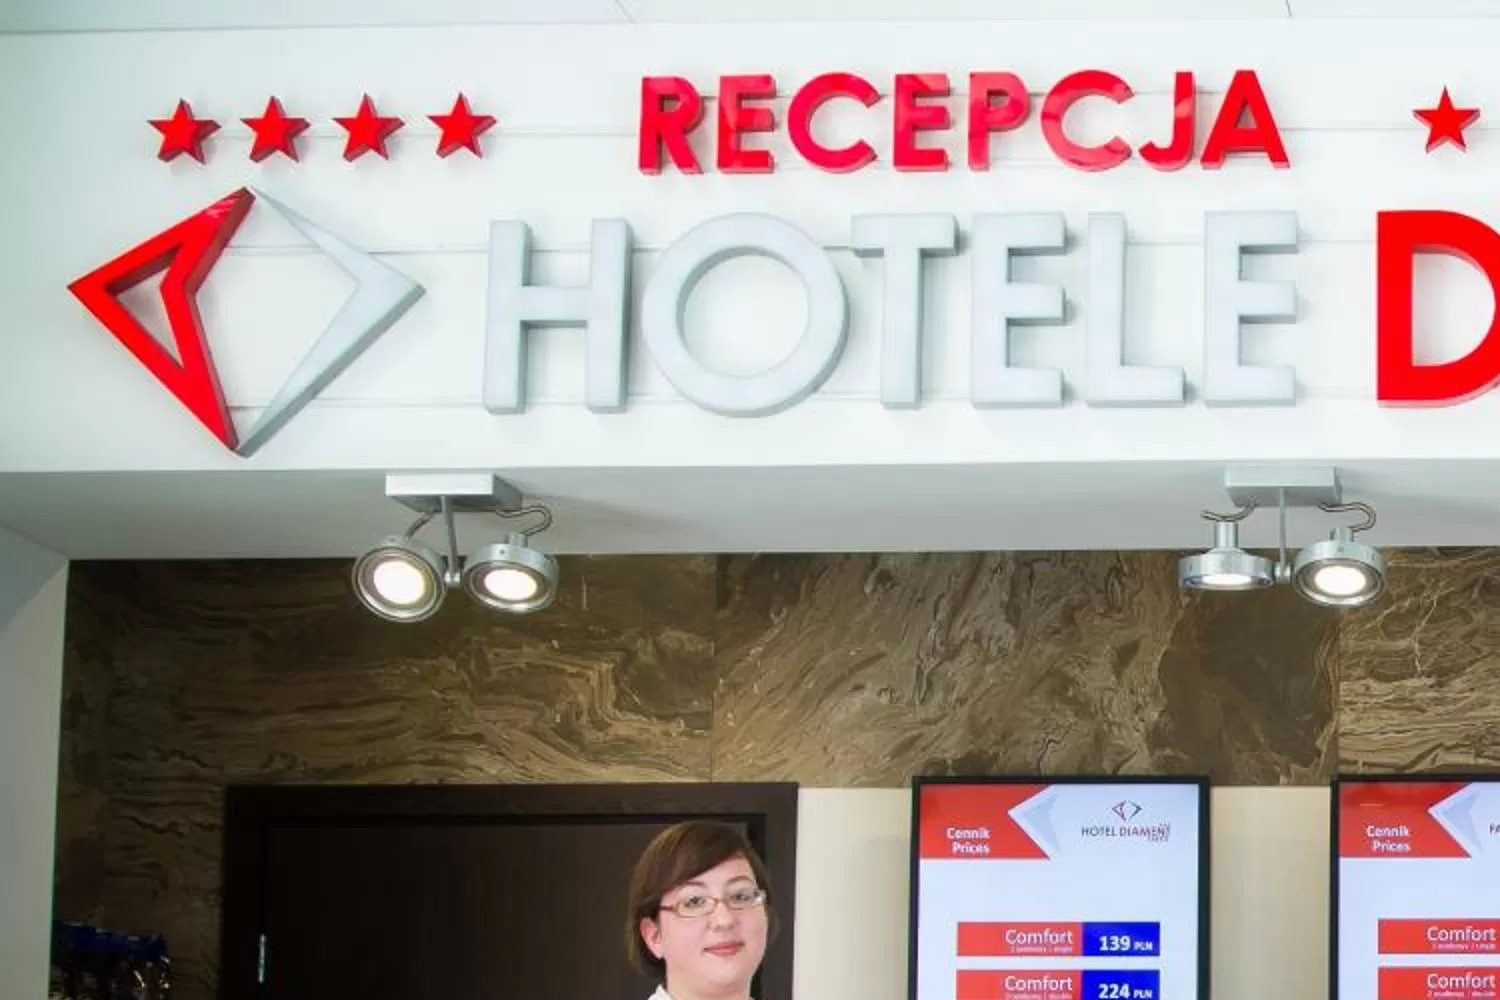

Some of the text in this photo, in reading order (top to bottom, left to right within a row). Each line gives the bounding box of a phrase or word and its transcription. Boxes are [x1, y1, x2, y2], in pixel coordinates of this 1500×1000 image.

[638, 69, 1291, 176] RECEPCJA
[483, 211, 1298, 418] HOTELE
[946, 827, 991, 840] Cennik
[1080, 823, 1171, 837] HOTEL DIAMENT
[1366, 824, 1409, 838] Cennik
[952, 841, 991, 854] Prices
[1372, 839, 1412, 853] Prices
[1004, 928, 1153, 952] Comfort 139 PLN
[1426, 925, 1497, 942] Comfort
[1004, 975, 1153, 999] Comfort 224 PLN
[1426, 971, 1497, 989] Comfort
